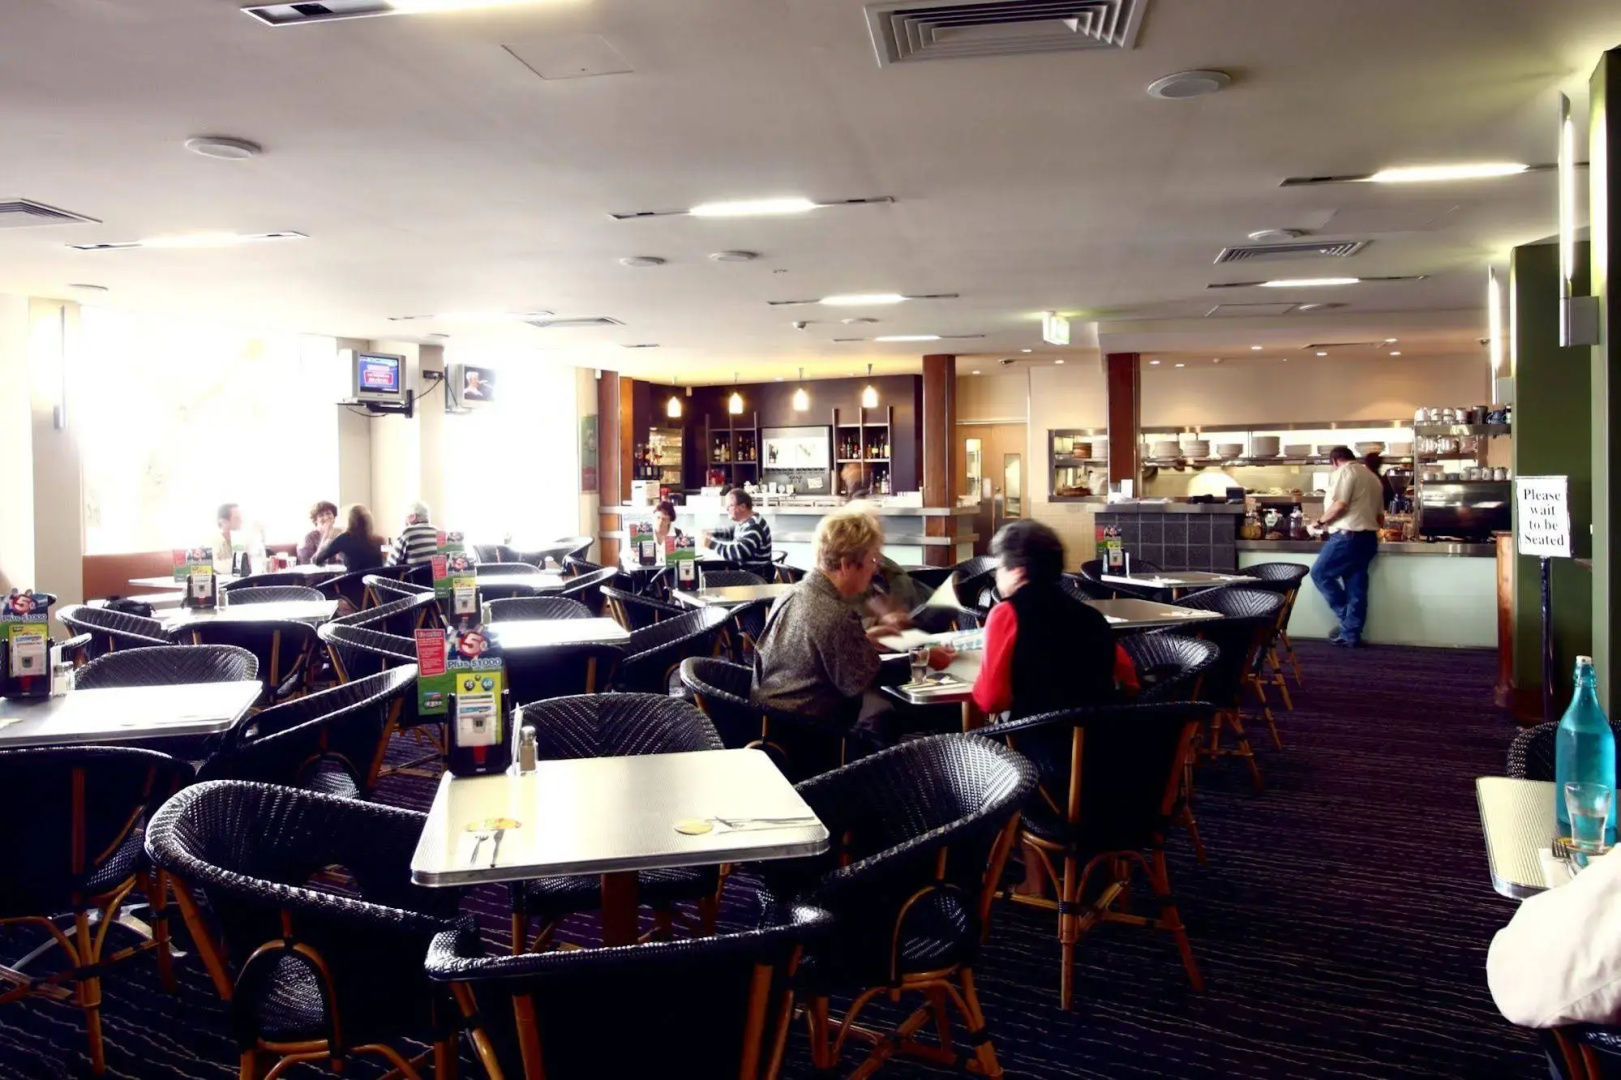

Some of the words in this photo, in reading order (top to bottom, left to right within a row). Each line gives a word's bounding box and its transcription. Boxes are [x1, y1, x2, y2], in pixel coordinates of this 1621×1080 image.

[1524, 488, 1561, 501] Please
[1530, 503, 1555, 516] wait
[1529, 519, 1541, 530] to
[1544, 518, 1558, 530] be
[1525, 533, 1564, 546] Seated
[447, 660, 470, 669] Plus
